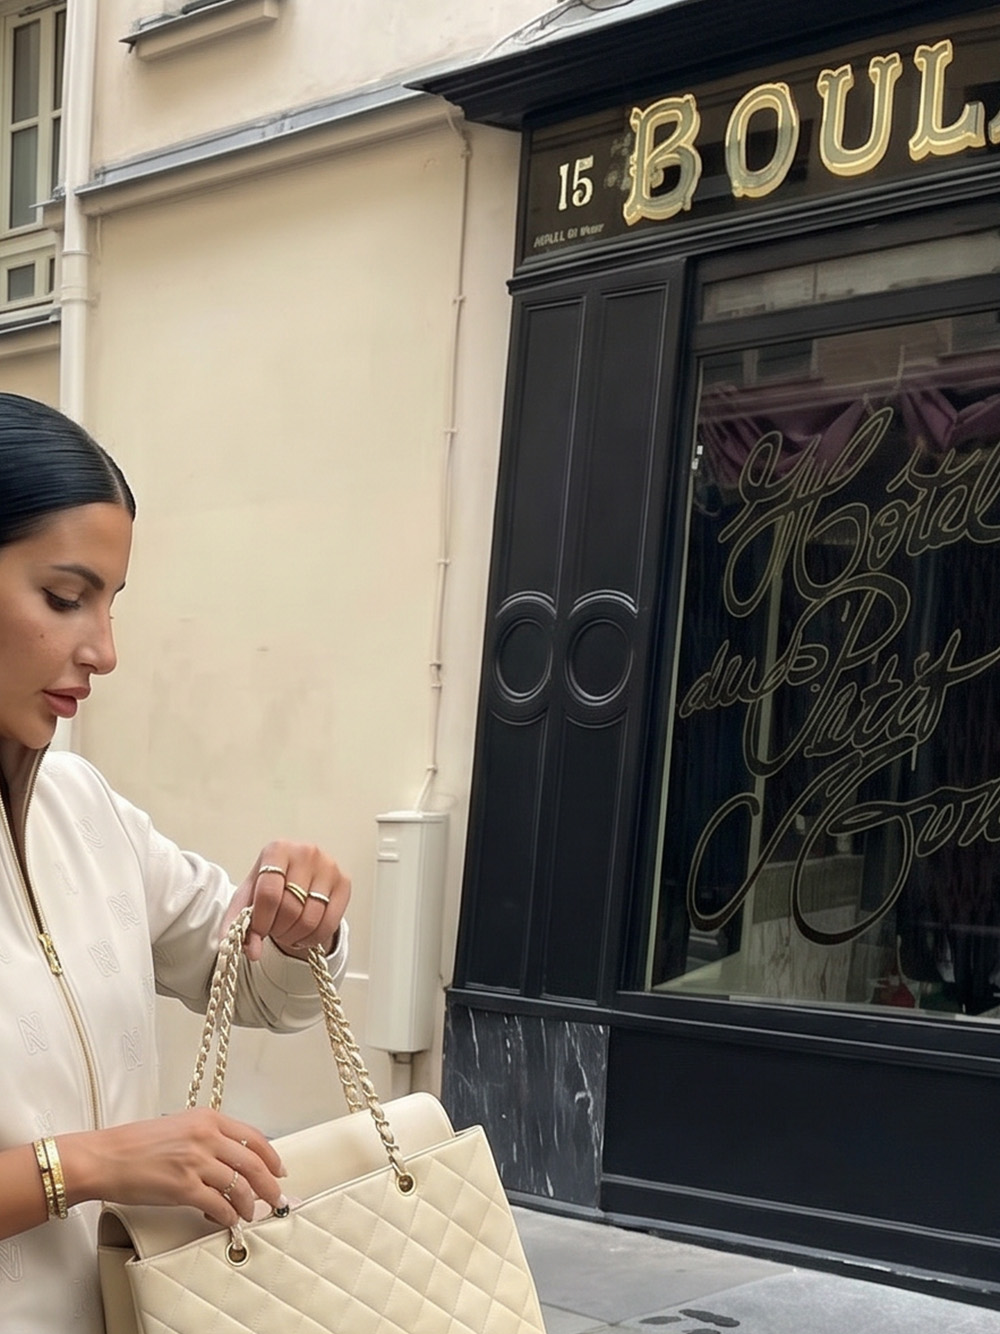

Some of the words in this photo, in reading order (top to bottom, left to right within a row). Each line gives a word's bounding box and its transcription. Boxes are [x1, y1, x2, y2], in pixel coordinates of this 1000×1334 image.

[623, 39, 1000, 226] BOUL
[558, 155, 594, 211] 15
[17, 1010, 49, 1055] N
